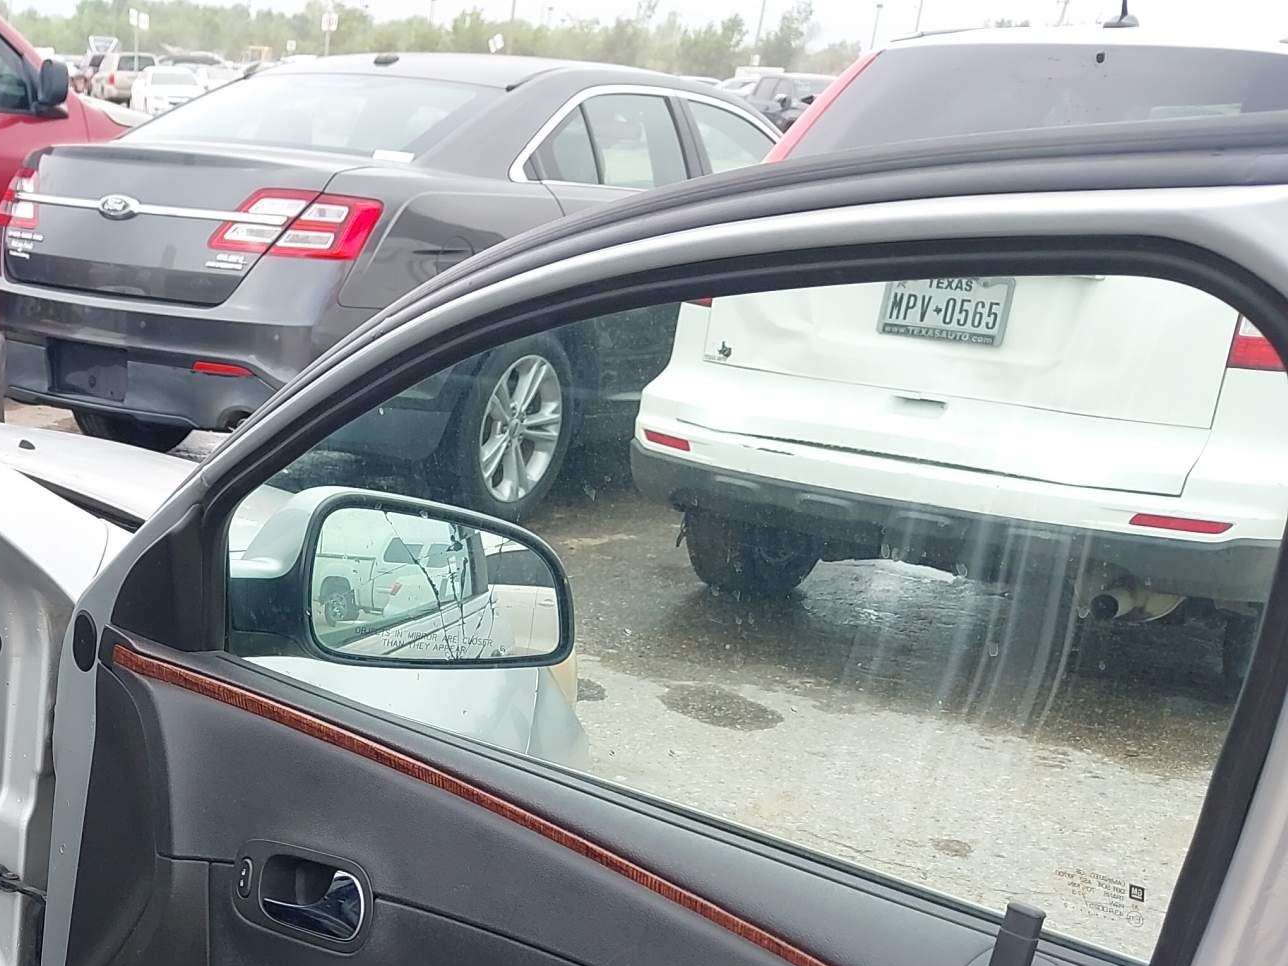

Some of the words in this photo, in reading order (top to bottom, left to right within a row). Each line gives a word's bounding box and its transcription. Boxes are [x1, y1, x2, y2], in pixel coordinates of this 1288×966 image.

[928, 277, 973, 292] TEXAS
[355, 626, 391, 637] OBJTS
[407, 631, 438, 641] MIRROR
